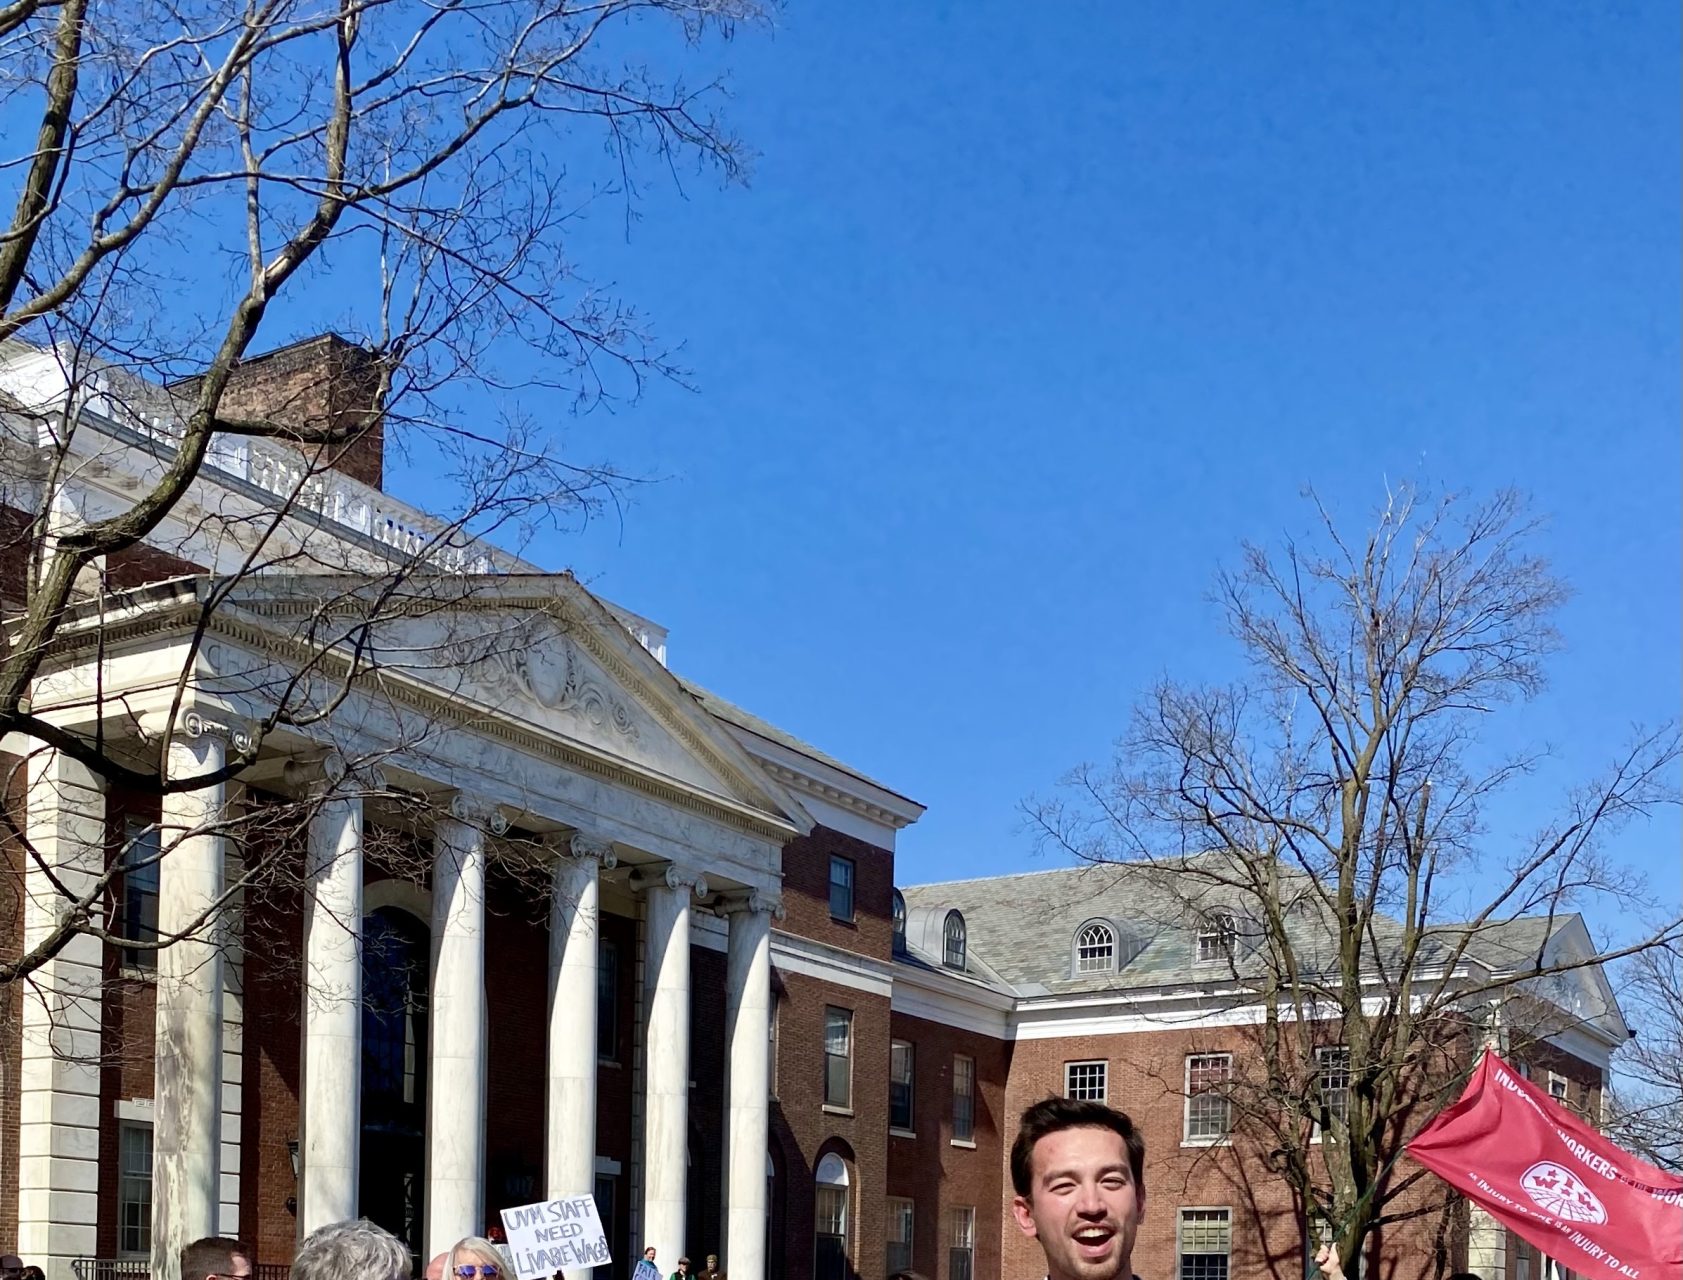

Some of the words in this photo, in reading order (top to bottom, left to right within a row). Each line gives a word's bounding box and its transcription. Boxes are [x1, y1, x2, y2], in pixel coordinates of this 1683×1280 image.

[1557, 1128, 1619, 1181] WORKERS
[1651, 1187, 1683, 1208] WOR
[504, 1205, 546, 1230] UVM
[547, 1198, 592, 1223] STAFF
[534, 1223, 583, 1243] NEED
[1477, 1179, 1513, 1206] INJURY
[1514, 1203, 1528, 1214] TO
[1568, 1231, 1607, 1260] INJURY
[1604, 1255, 1620, 1269] TO
[1618, 1262, 1640, 1280] ALL
